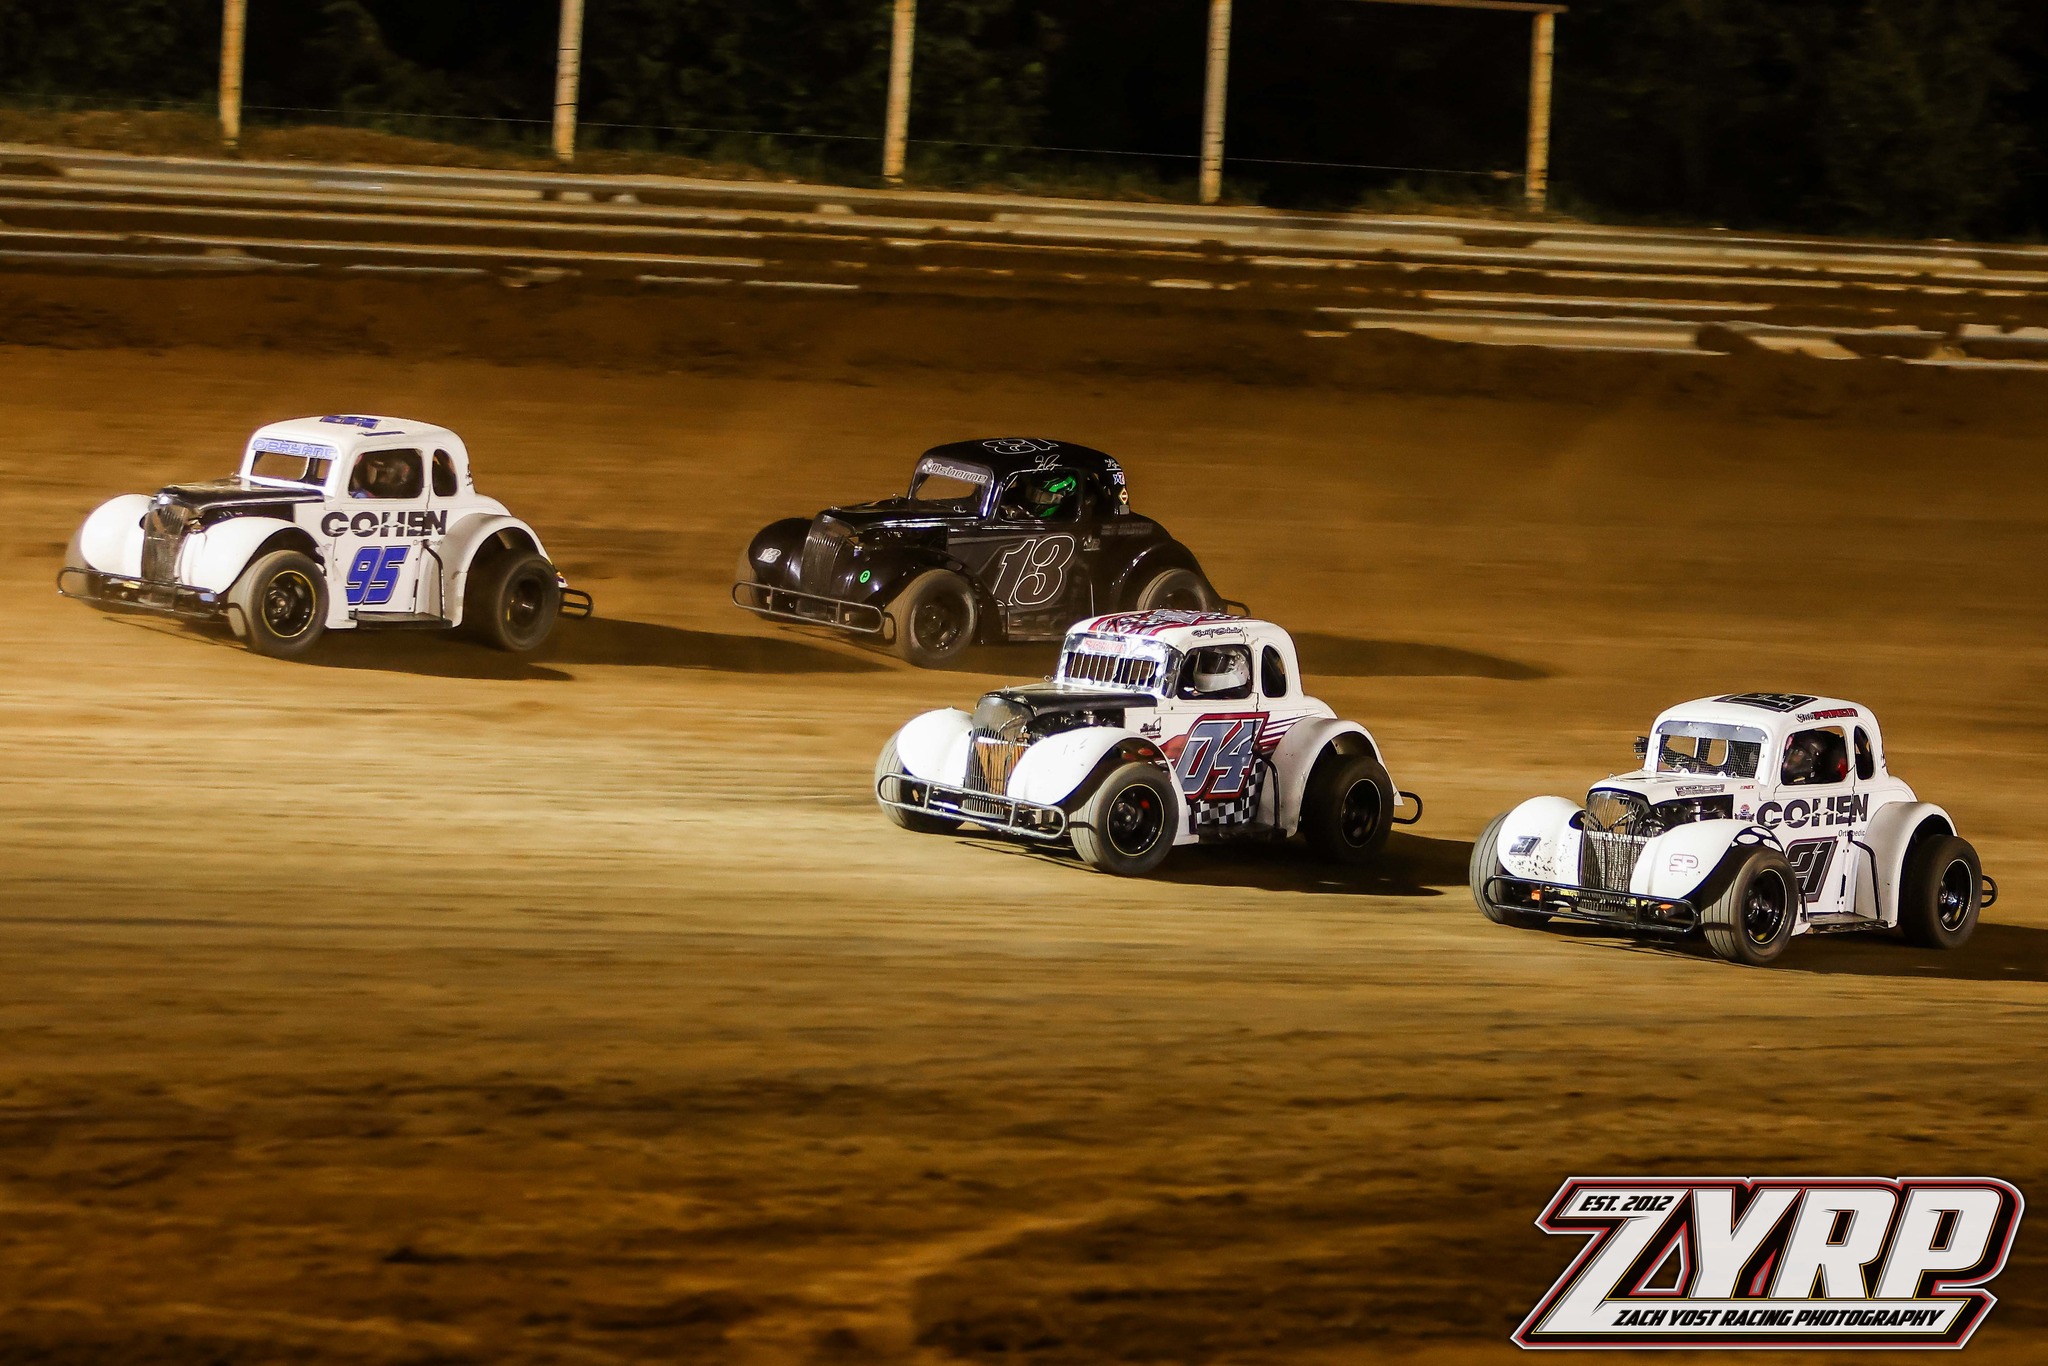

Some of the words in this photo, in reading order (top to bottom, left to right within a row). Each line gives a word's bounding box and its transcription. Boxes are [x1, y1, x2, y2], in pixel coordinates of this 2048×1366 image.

[321, 510, 448, 537] COHEN
[345, 545, 411, 605] 95
[992, 535, 1075, 607] 13
[1174, 716, 1266, 796] 04
[1757, 794, 1869, 830] COHEN
[1669, 854, 1699, 873] SP
